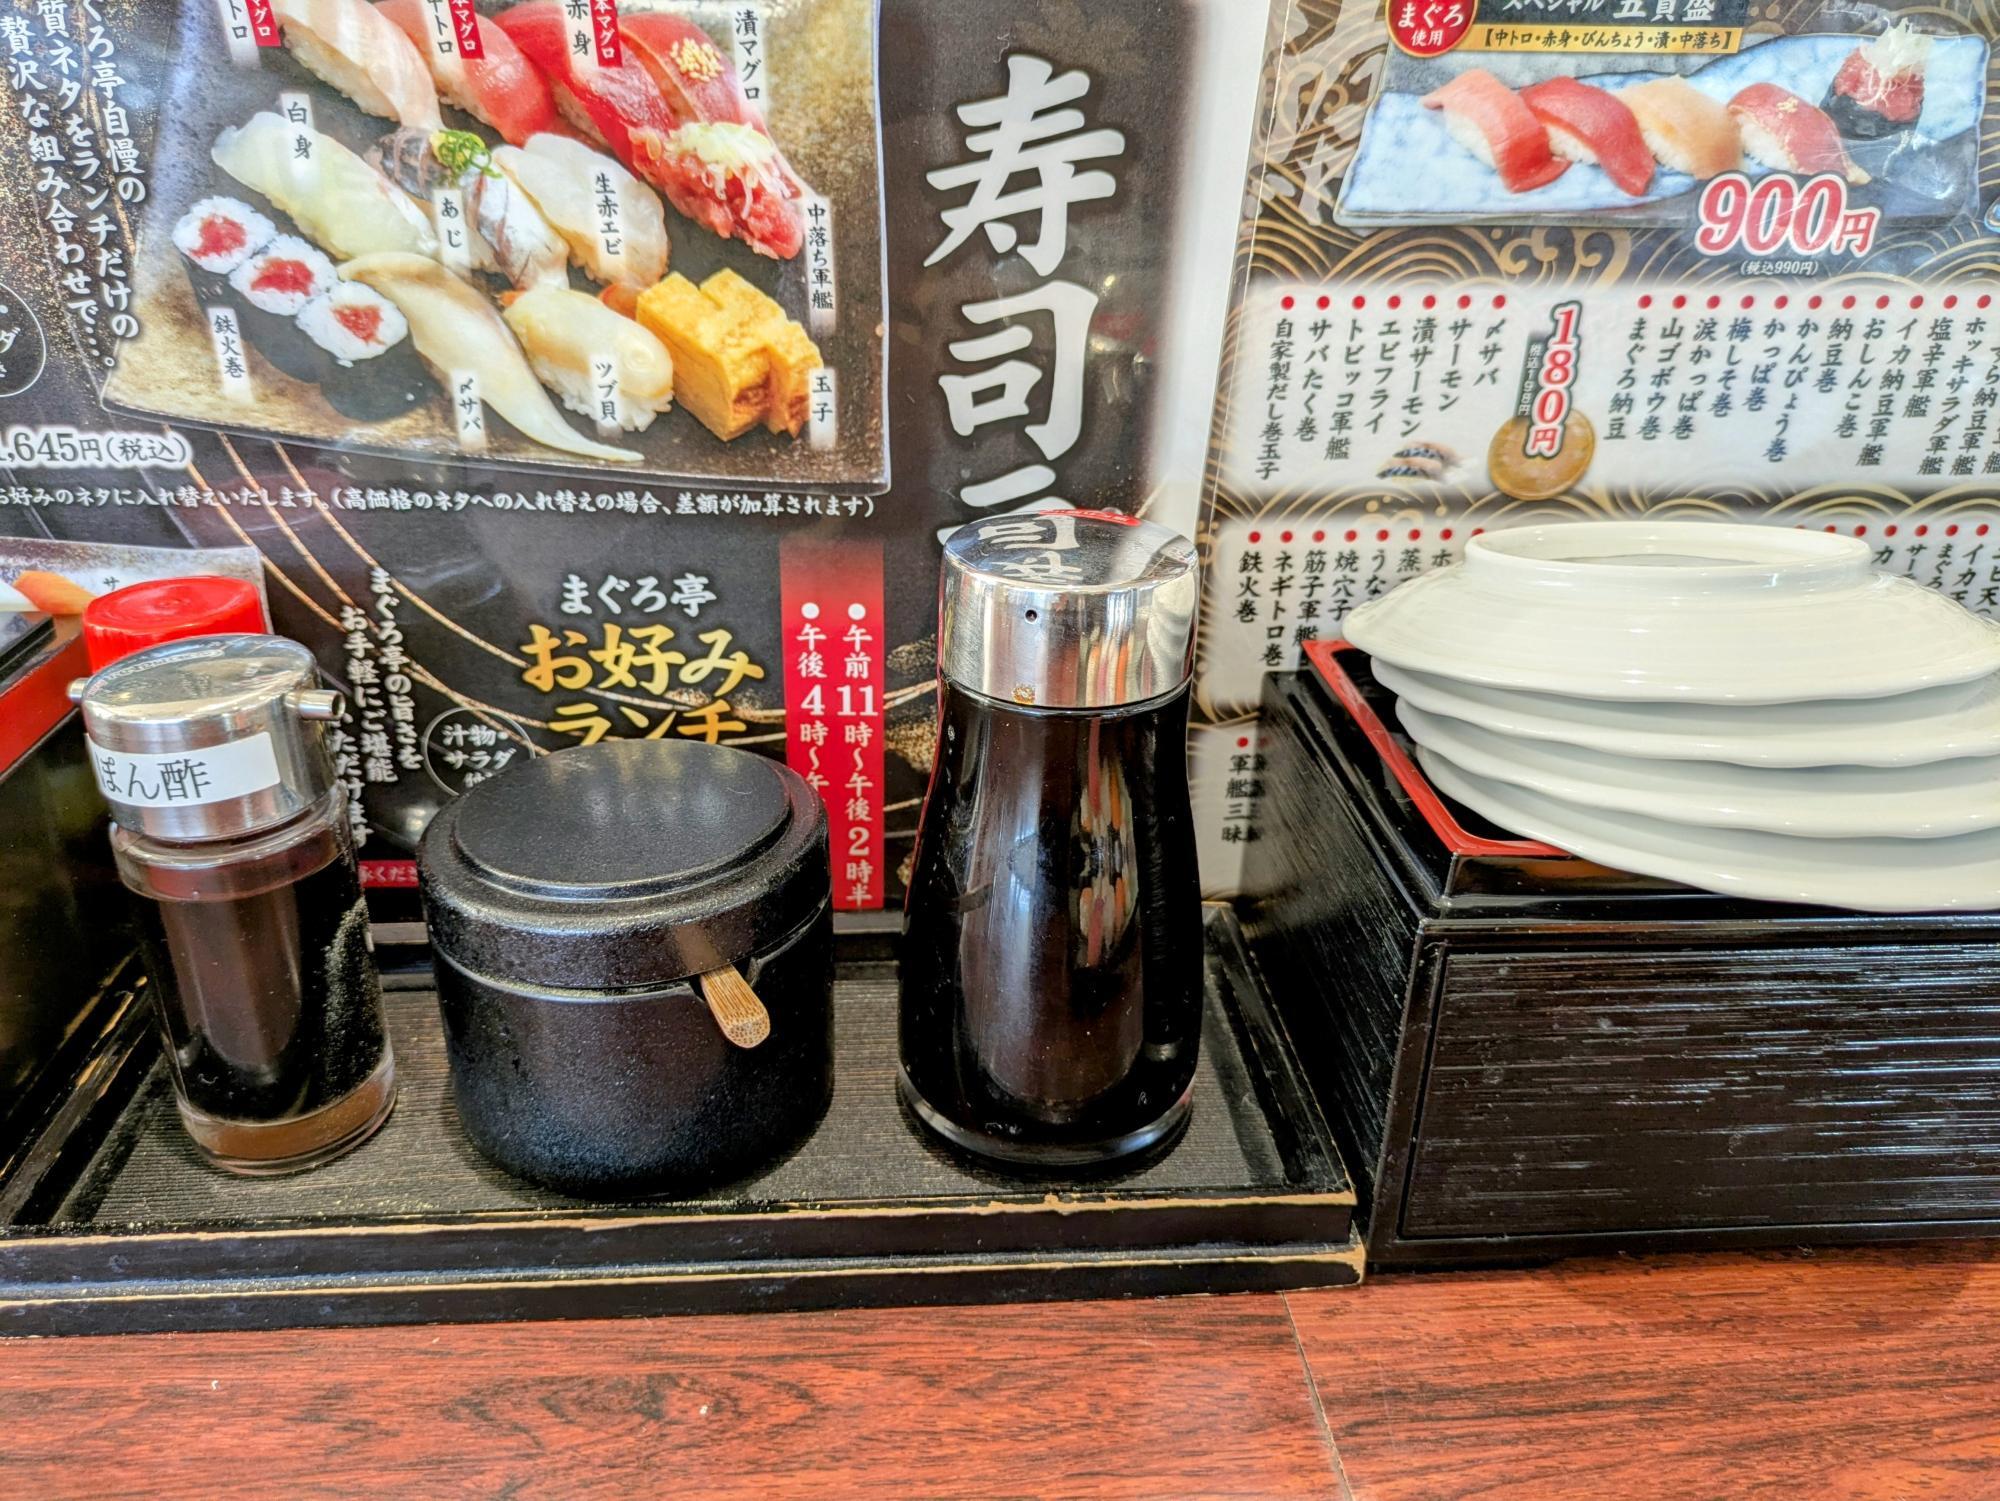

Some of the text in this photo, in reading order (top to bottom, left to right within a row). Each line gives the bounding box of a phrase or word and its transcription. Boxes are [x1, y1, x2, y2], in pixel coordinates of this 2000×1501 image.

[735, 10, 762, 99] 漬マグロ
[1398, 2, 1464, 28] まぐろ
[1411, 29, 1443, 46] 使用
[287, 101, 313, 160] 白身
[441, 198, 463, 249] あじ
[595, 173, 622, 256] 生赤エビ
[807, 203, 834, 310] 中落ち軍艦
[1699, 174, 1878, 256] 900円
[214, 314, 246, 378] 鉄火巻
[595, 361, 618, 423] ツブ貝
[1294, 319, 1332, 443] サバたく巻
[1324, 318, 1364, 462] トビッコ軍艦
[1365, 319, 1401, 435] エビフライ
[1400, 317, 1439, 439] 漬サーモン
[1438, 318, 1472, 413] サーモン
[1529, 307, 1576, 453] 180円
[1603, 317, 1647, 441] まぐろ納豆
[1636, 317, 1684, 441] 山ゴボウ巻
[1669, 317, 1718, 441] 涙かっぱ巻
[1707, 316, 1753, 418] 梅しそ巻
[1742, 318, 1786, 412] かっぱ巻
[1763, 318, 1820, 463] かんぴょう巻
[1814, 317, 1852, 394] 納豆巻
[1835, 318, 1885, 439] おしんこ巻
[1856, 318, 1919, 467] イカ納豆軍艦
[1902, 317, 1953, 418] 塩辛軍艦
[811, 376, 833, 423] 玉子
[1255, 318, 1295, 481] 自家製だし巻玉子
[1917, 317, 1987, 475] ホッキサラダ軍艦
[560, 573, 717, 617] まぐろ亭
[1233, 551, 1264, 624] 鉄火巻
[1259, 551, 1295, 667] ネギトロ巻
[520, 623, 765, 697] お好み
[443, 747, 517, 770] サラダ
